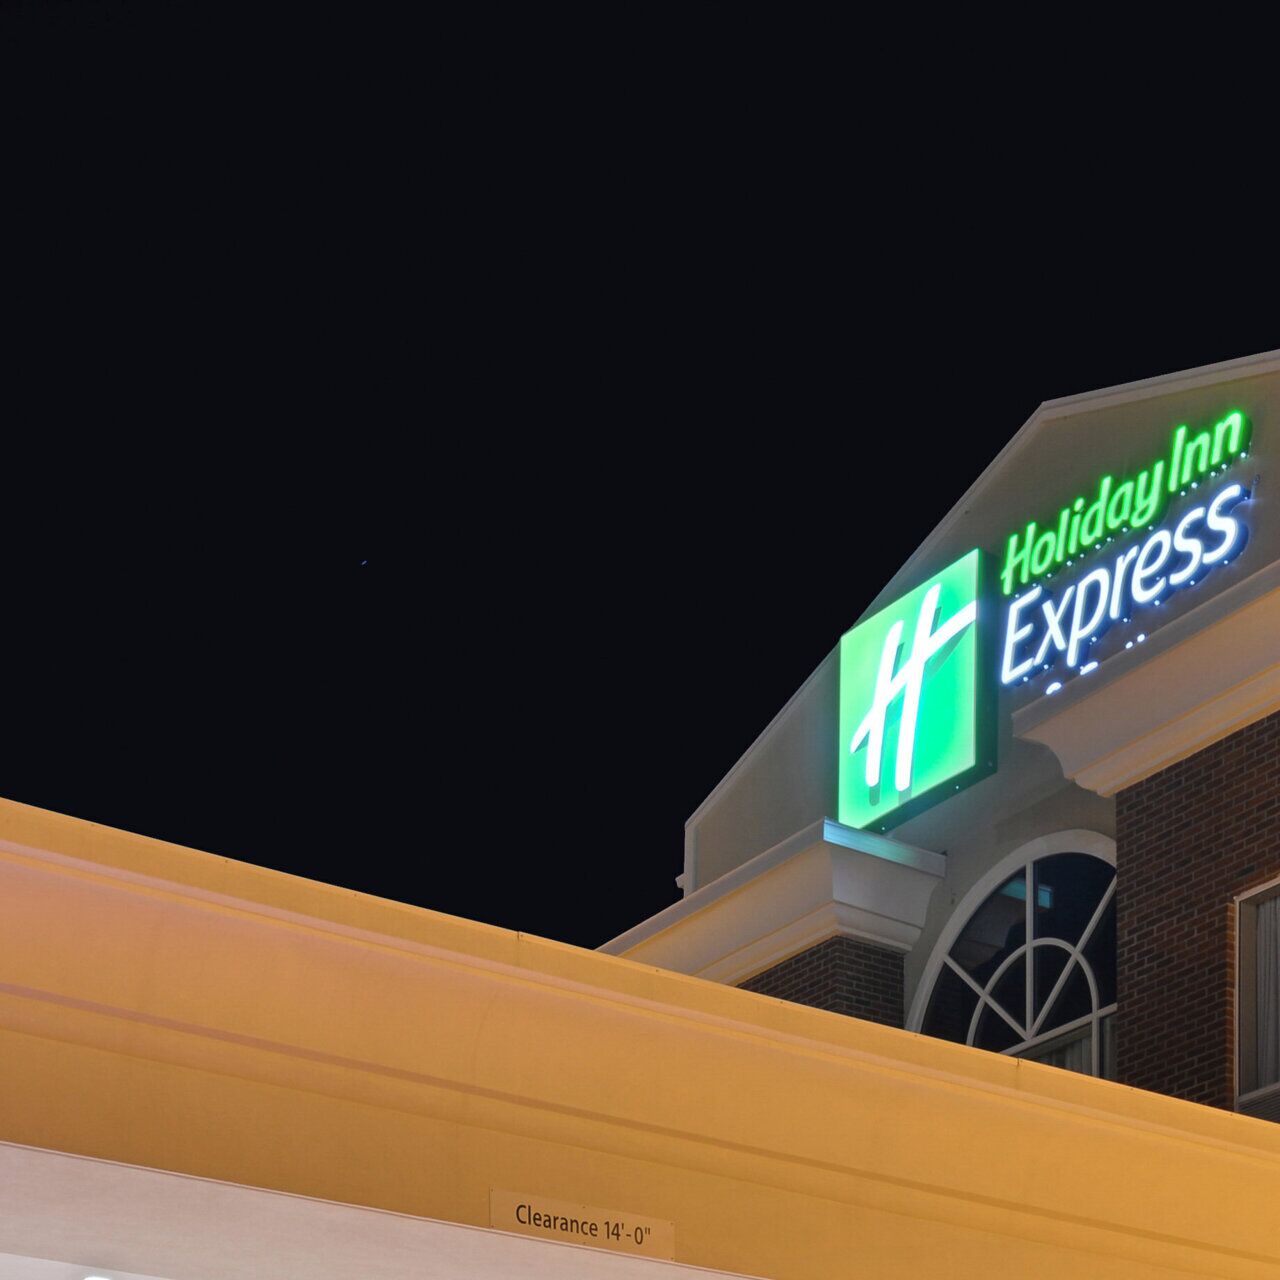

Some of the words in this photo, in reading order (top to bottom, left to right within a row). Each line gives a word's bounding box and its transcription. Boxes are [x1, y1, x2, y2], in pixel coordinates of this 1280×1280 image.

[1001, 461, 1164, 595] Holiday
[1168, 409, 1244, 491] Inn
[1001, 483, 1242, 686] Express
[515, 1204, 598, 1237] Clearance
